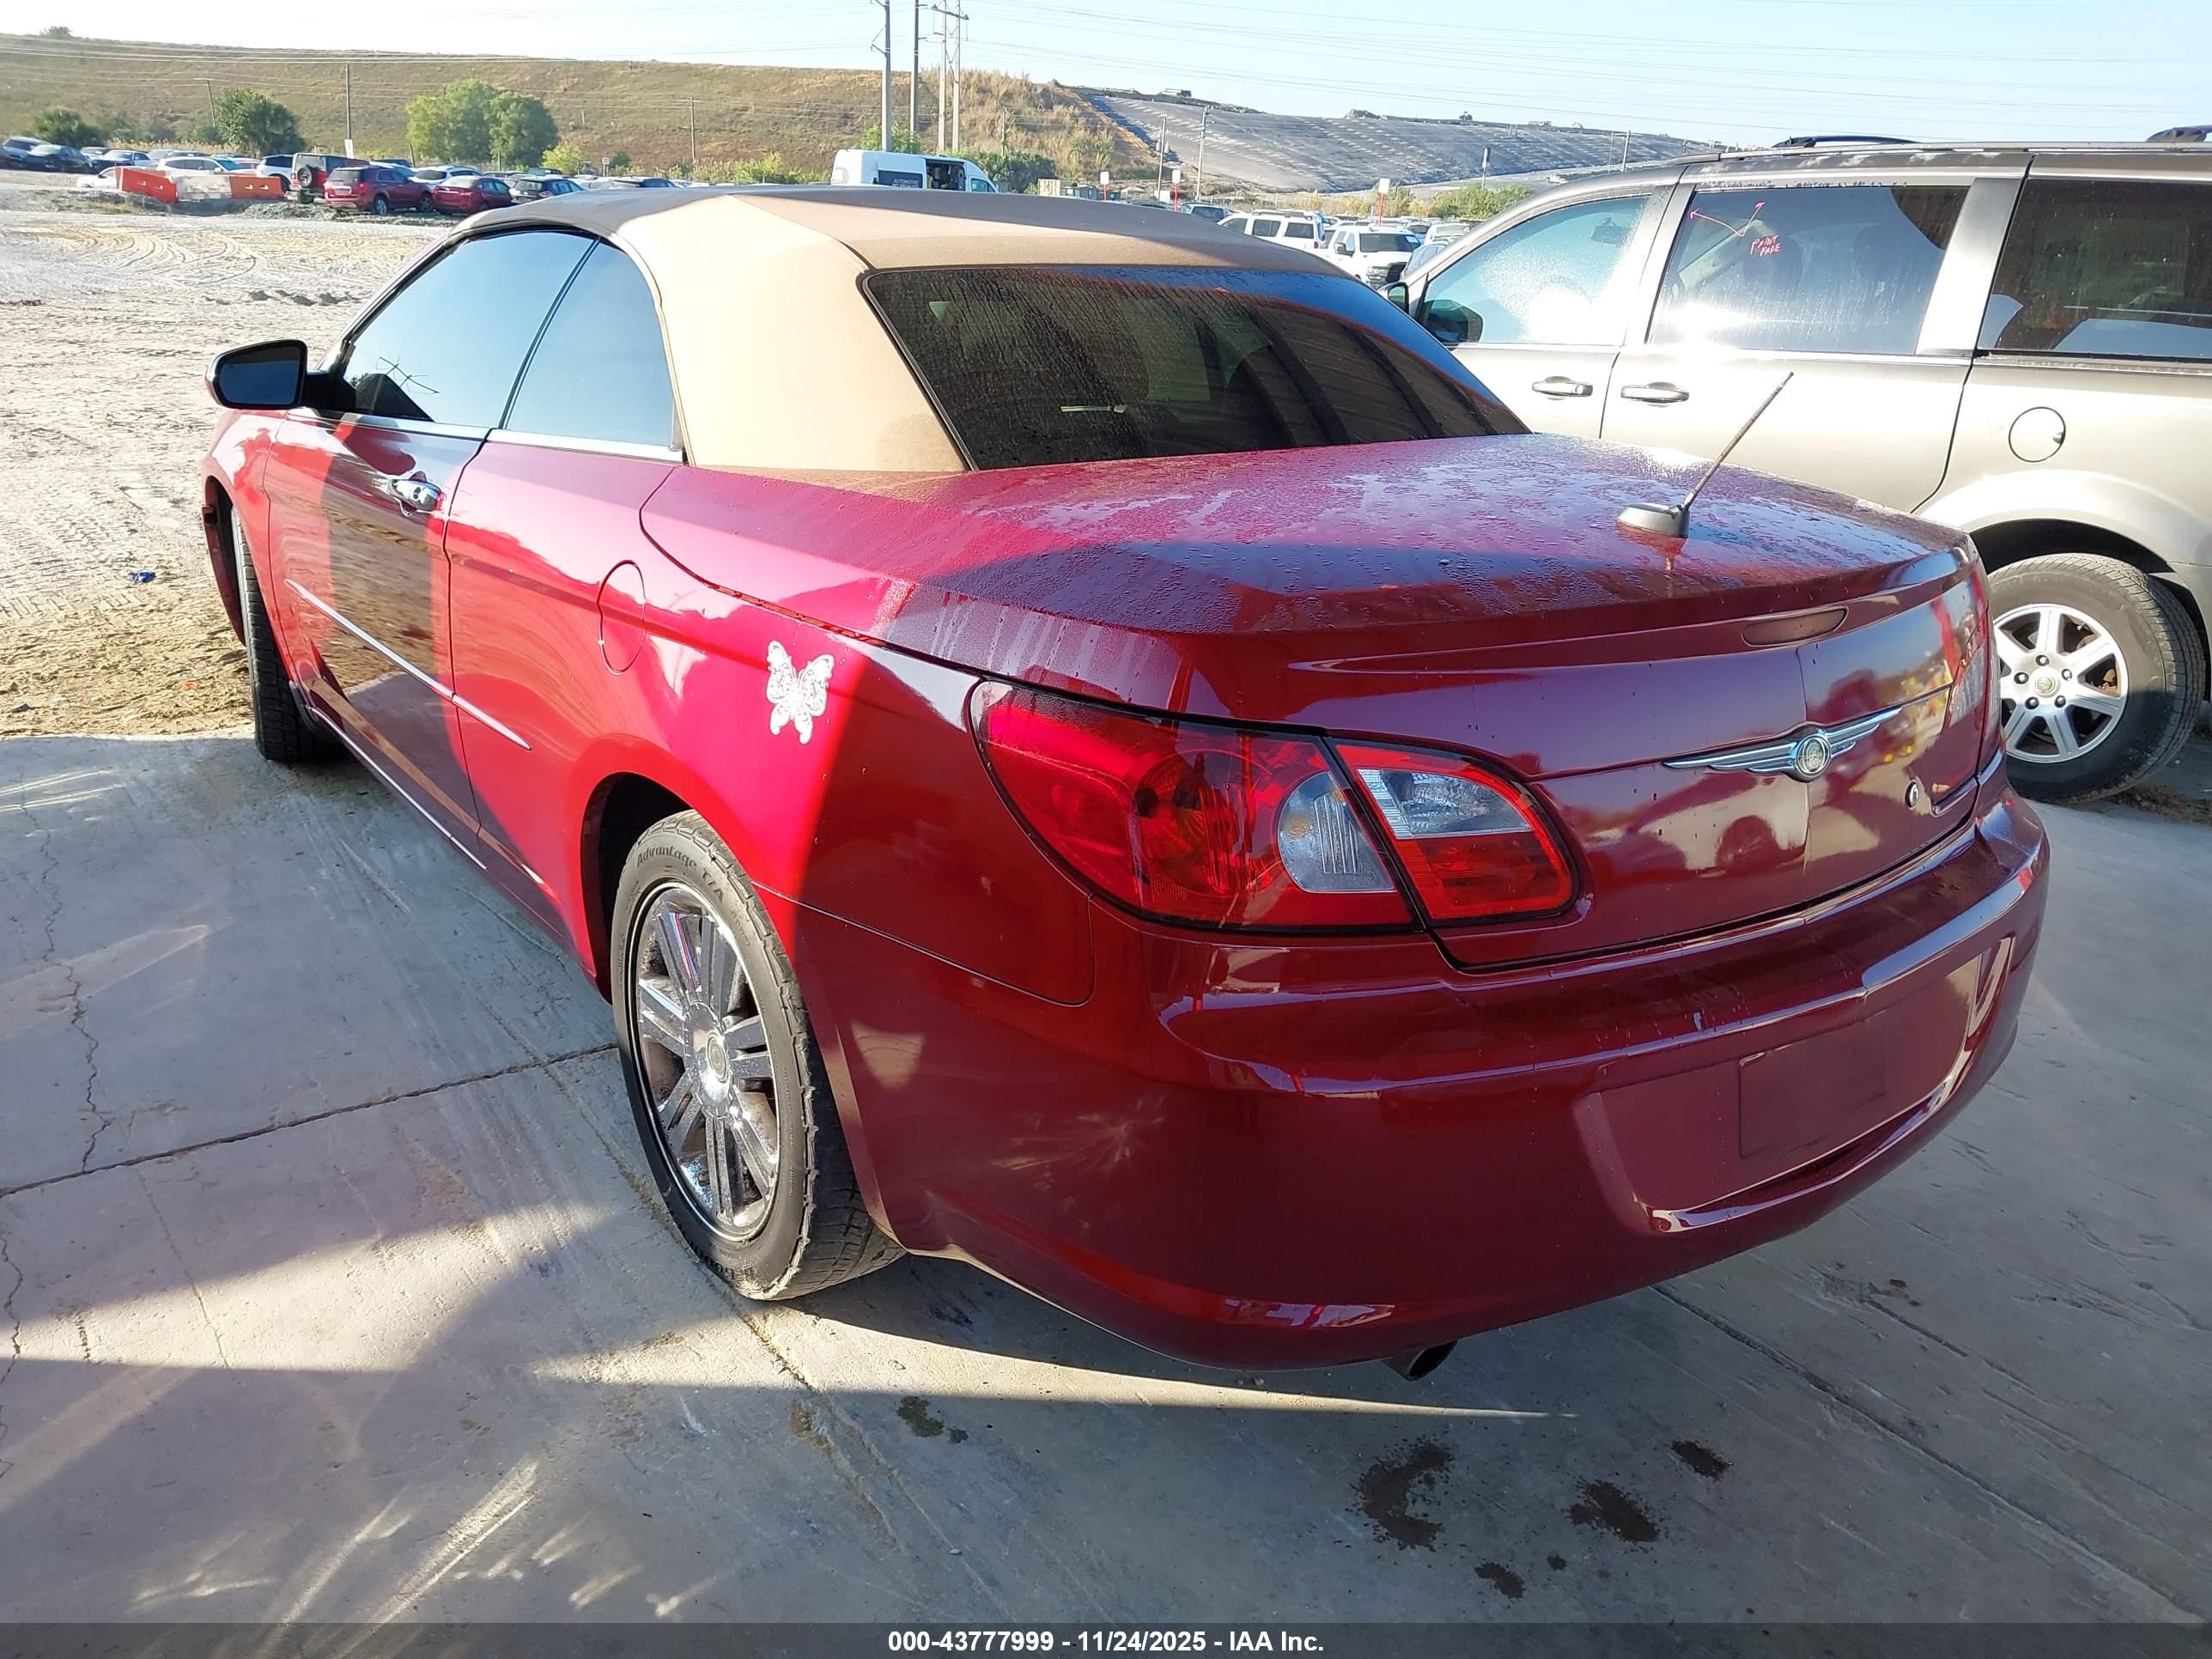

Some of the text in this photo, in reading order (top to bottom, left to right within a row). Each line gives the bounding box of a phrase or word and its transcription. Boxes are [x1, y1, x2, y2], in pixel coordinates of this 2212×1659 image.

[1750, 234, 1779, 254] PAINT
[1759, 242, 1781, 257] FADE
[636, 845, 697, 870] Advantage
